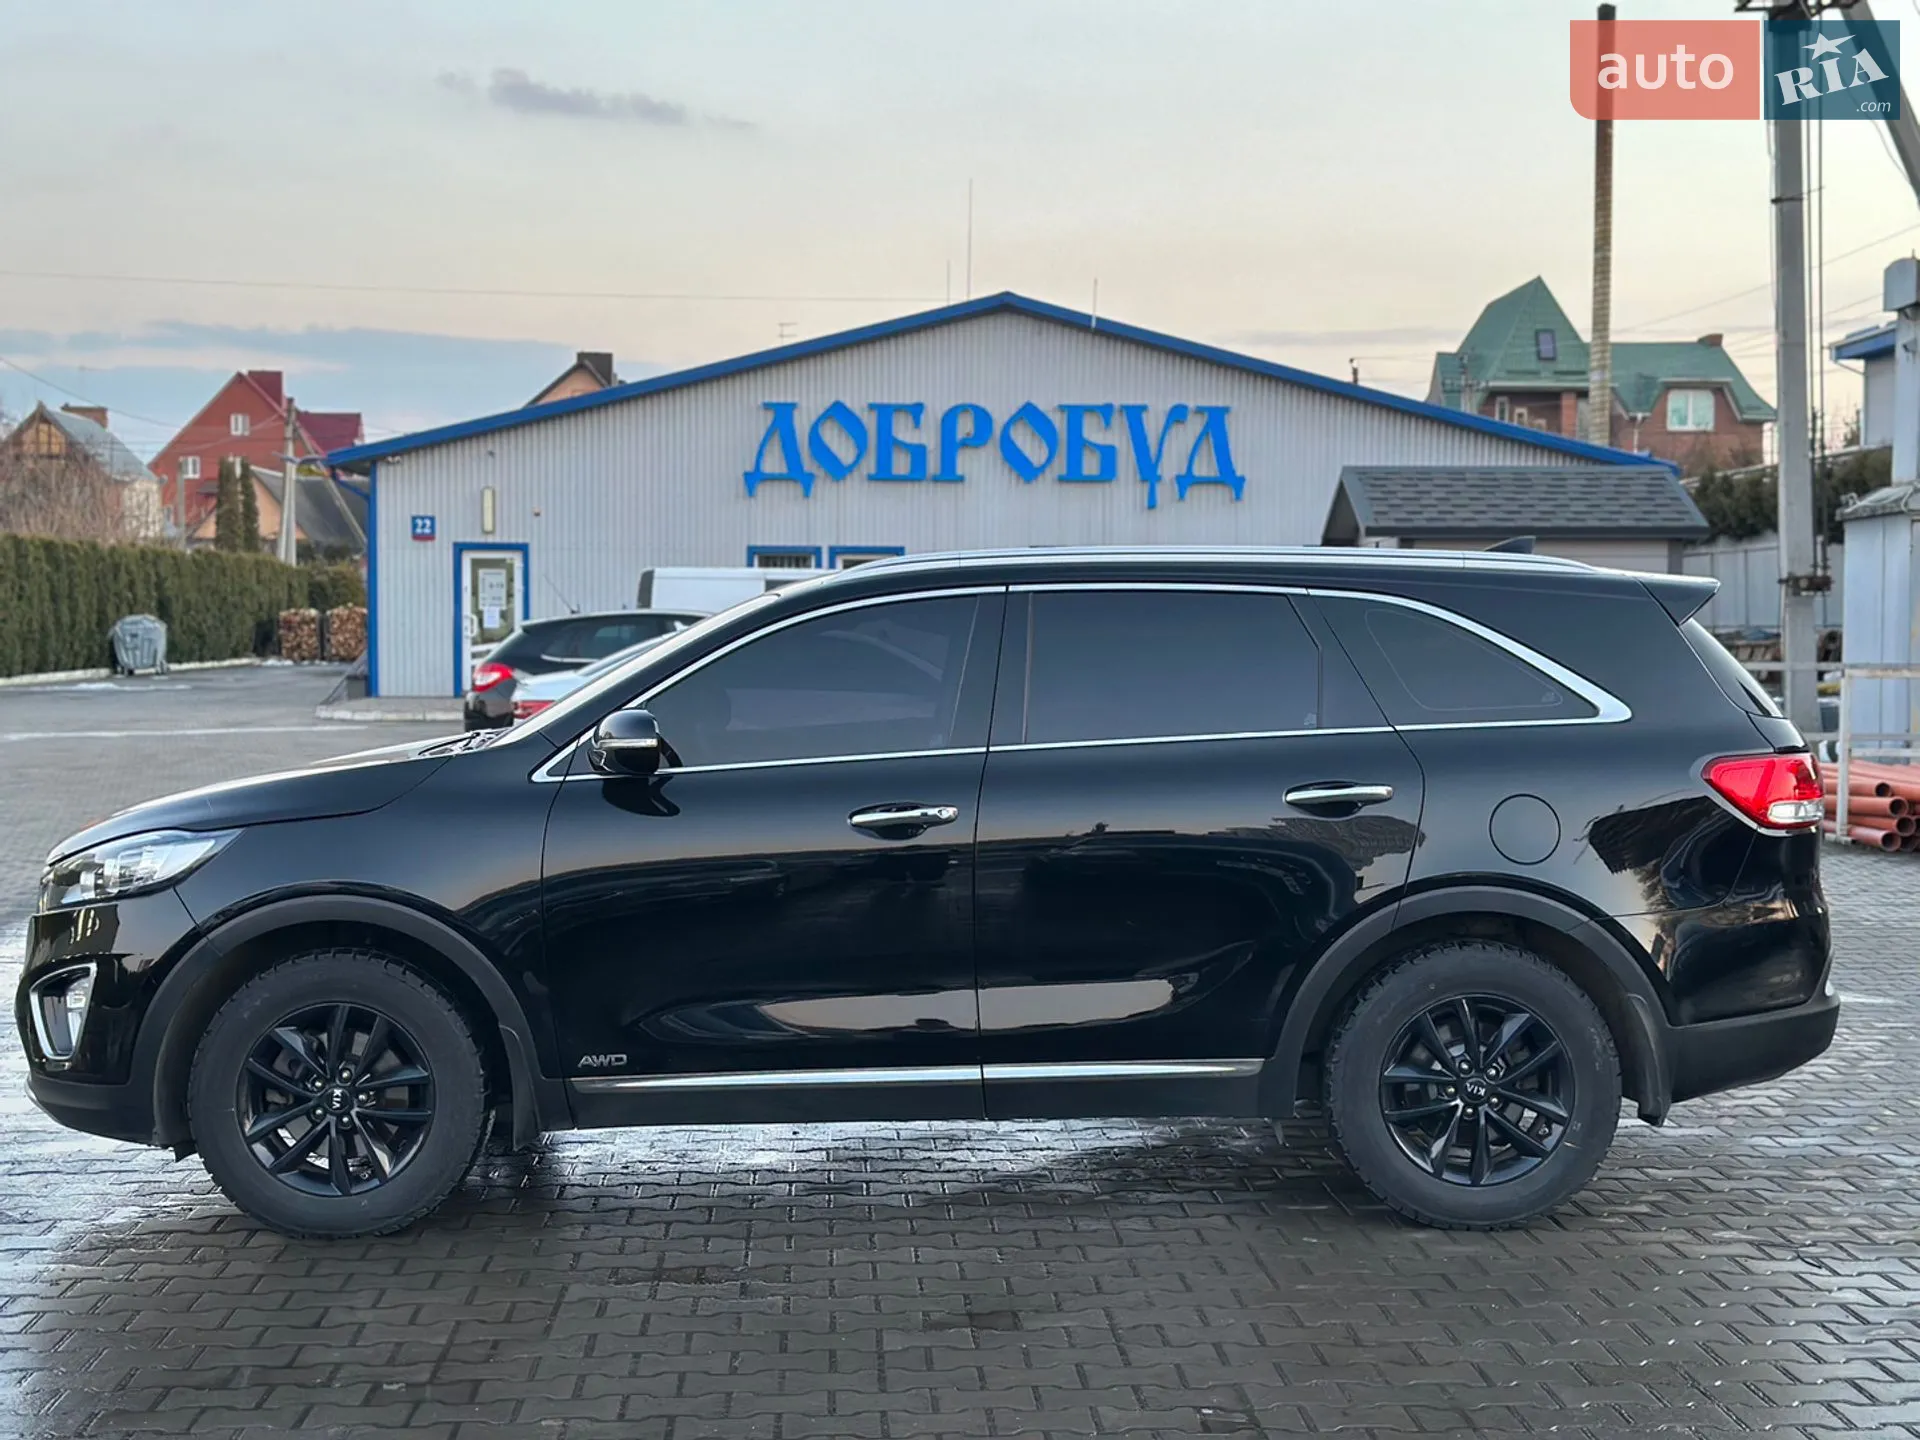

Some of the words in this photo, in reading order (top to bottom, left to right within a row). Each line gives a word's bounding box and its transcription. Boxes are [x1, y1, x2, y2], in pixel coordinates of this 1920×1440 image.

[743, 400, 1247, 508] ДОБРОБУД
[415, 518, 432, 534] 22
[578, 1054, 627, 1068] AWD
[1465, 1082, 1486, 1096] KIA
